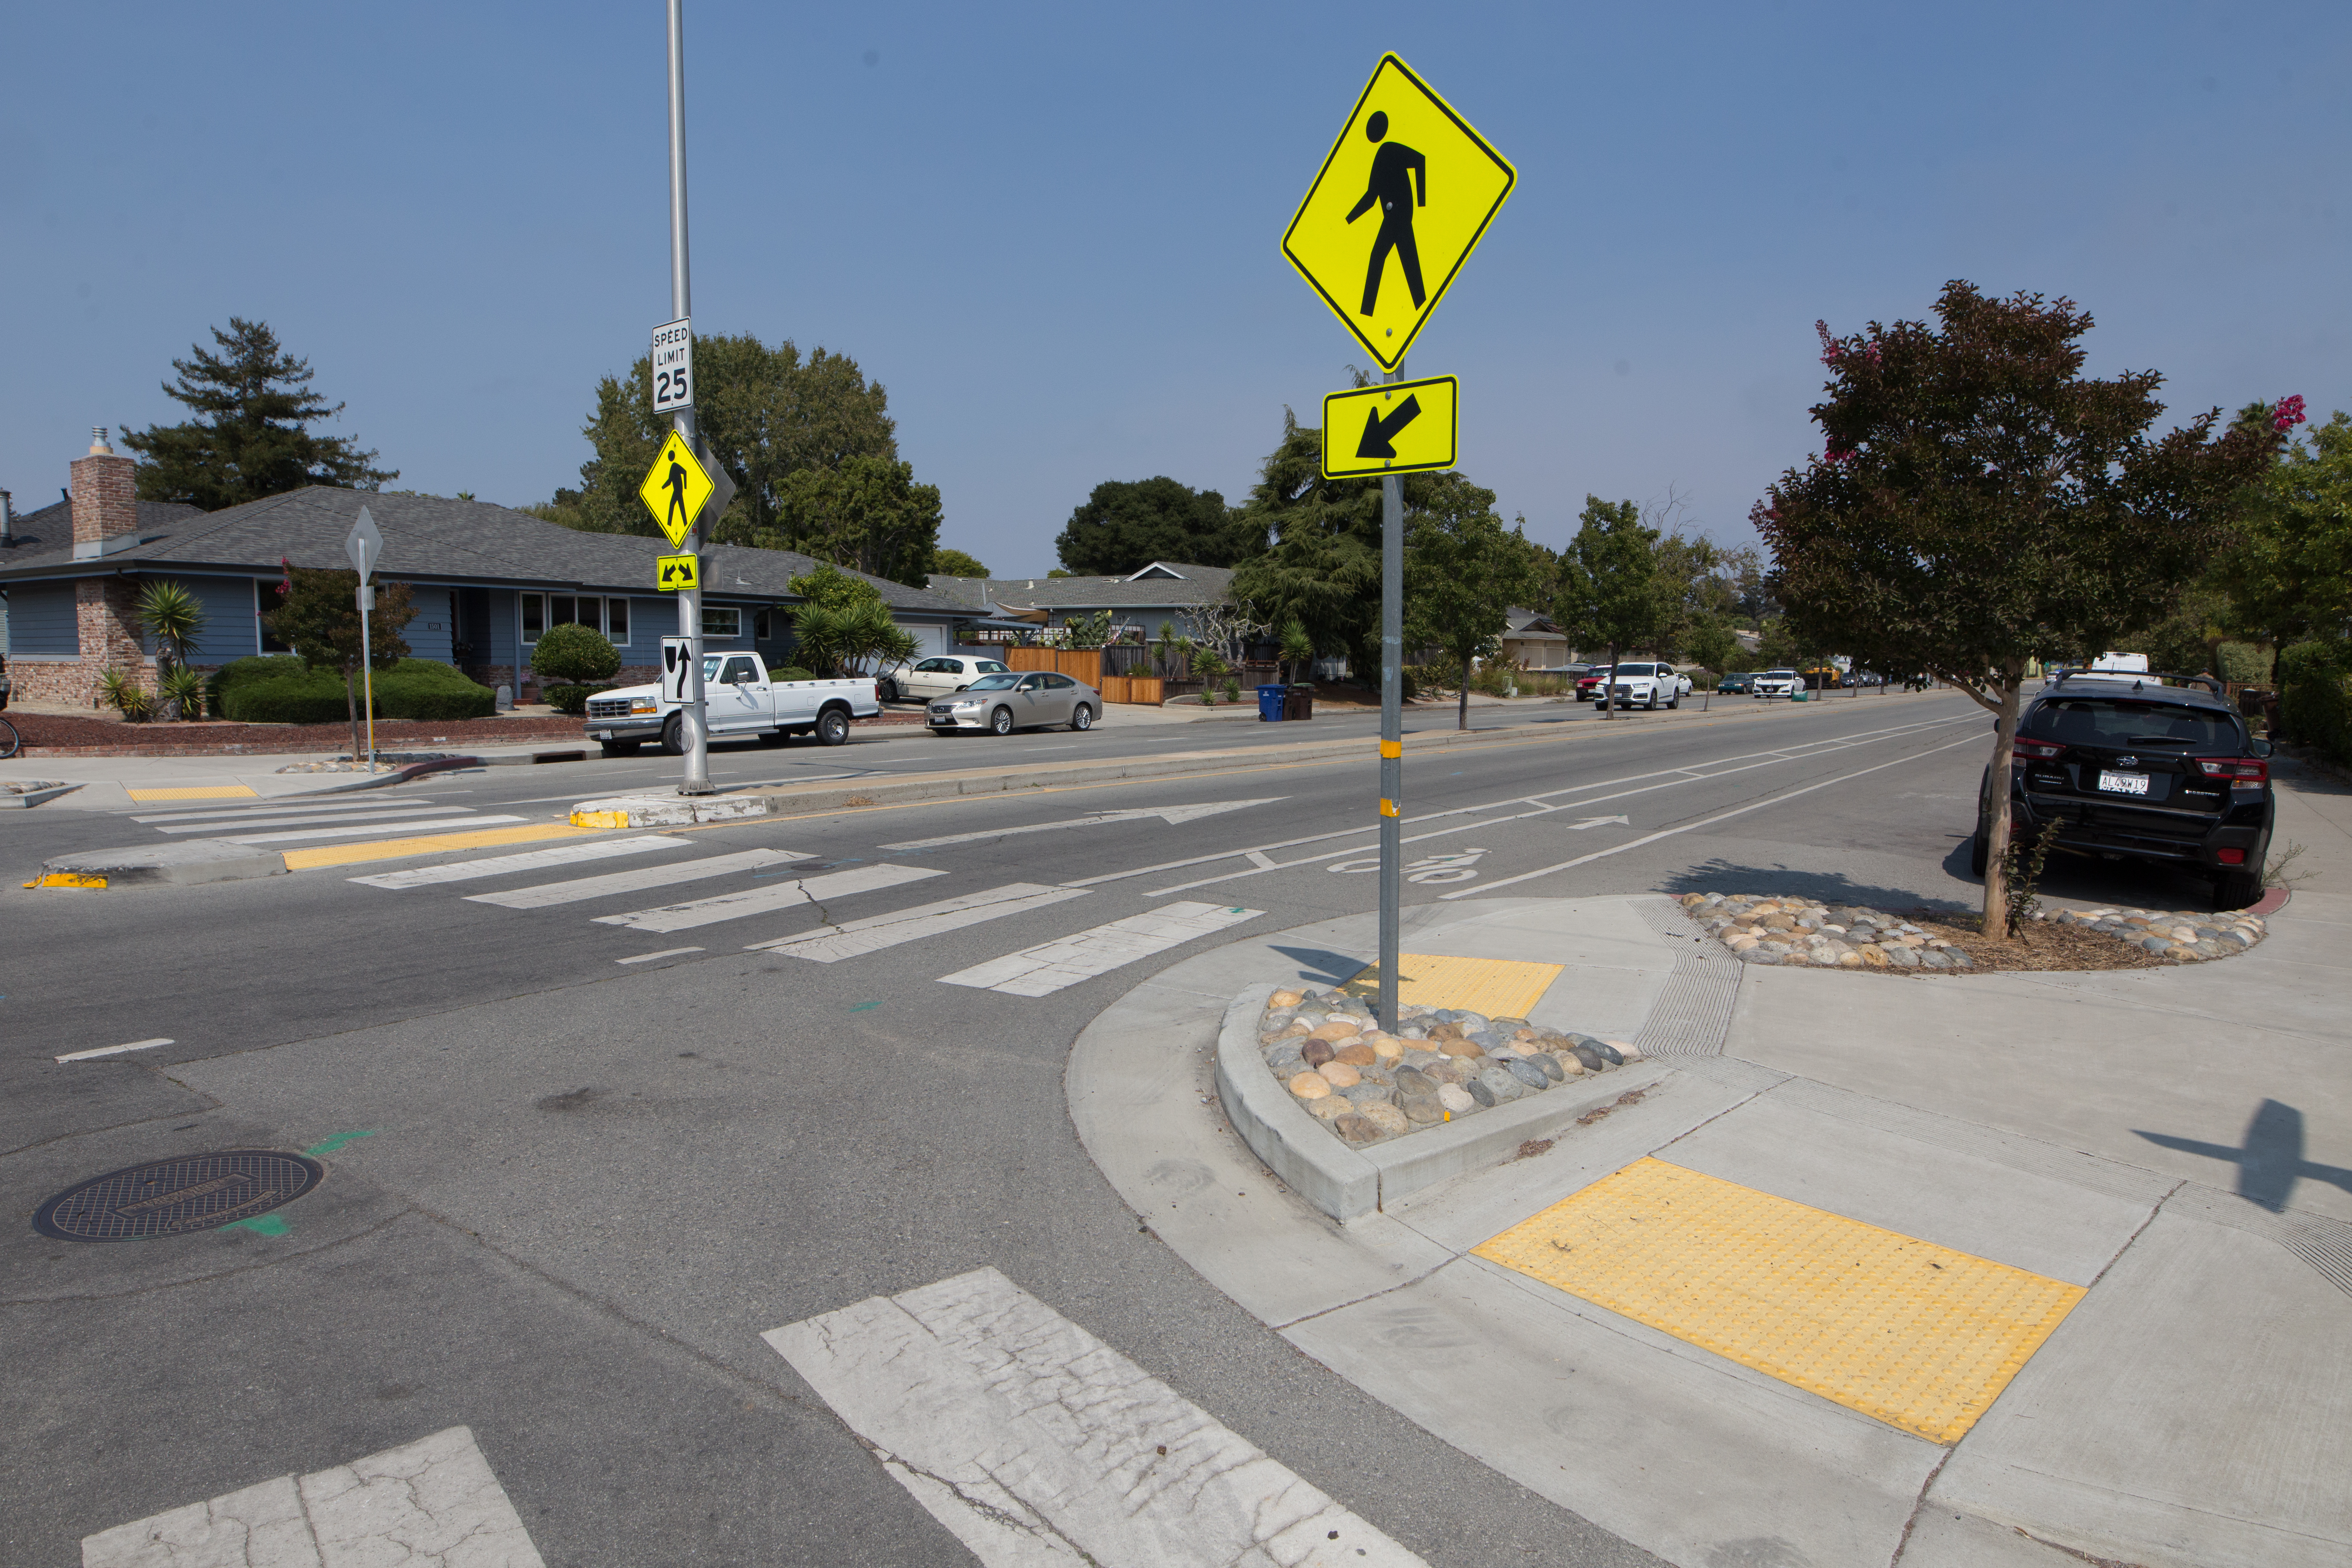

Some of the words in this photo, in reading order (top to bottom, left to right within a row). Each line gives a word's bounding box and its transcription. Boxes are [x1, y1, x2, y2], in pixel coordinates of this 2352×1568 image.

[655, 328, 688, 347] SPEED
[658, 348, 685, 366] LIMIT
[657, 368, 687, 404] 25
[2099, 786, 2146, 795] MAITA
[2102, 776, 2146, 790] AL49W19
